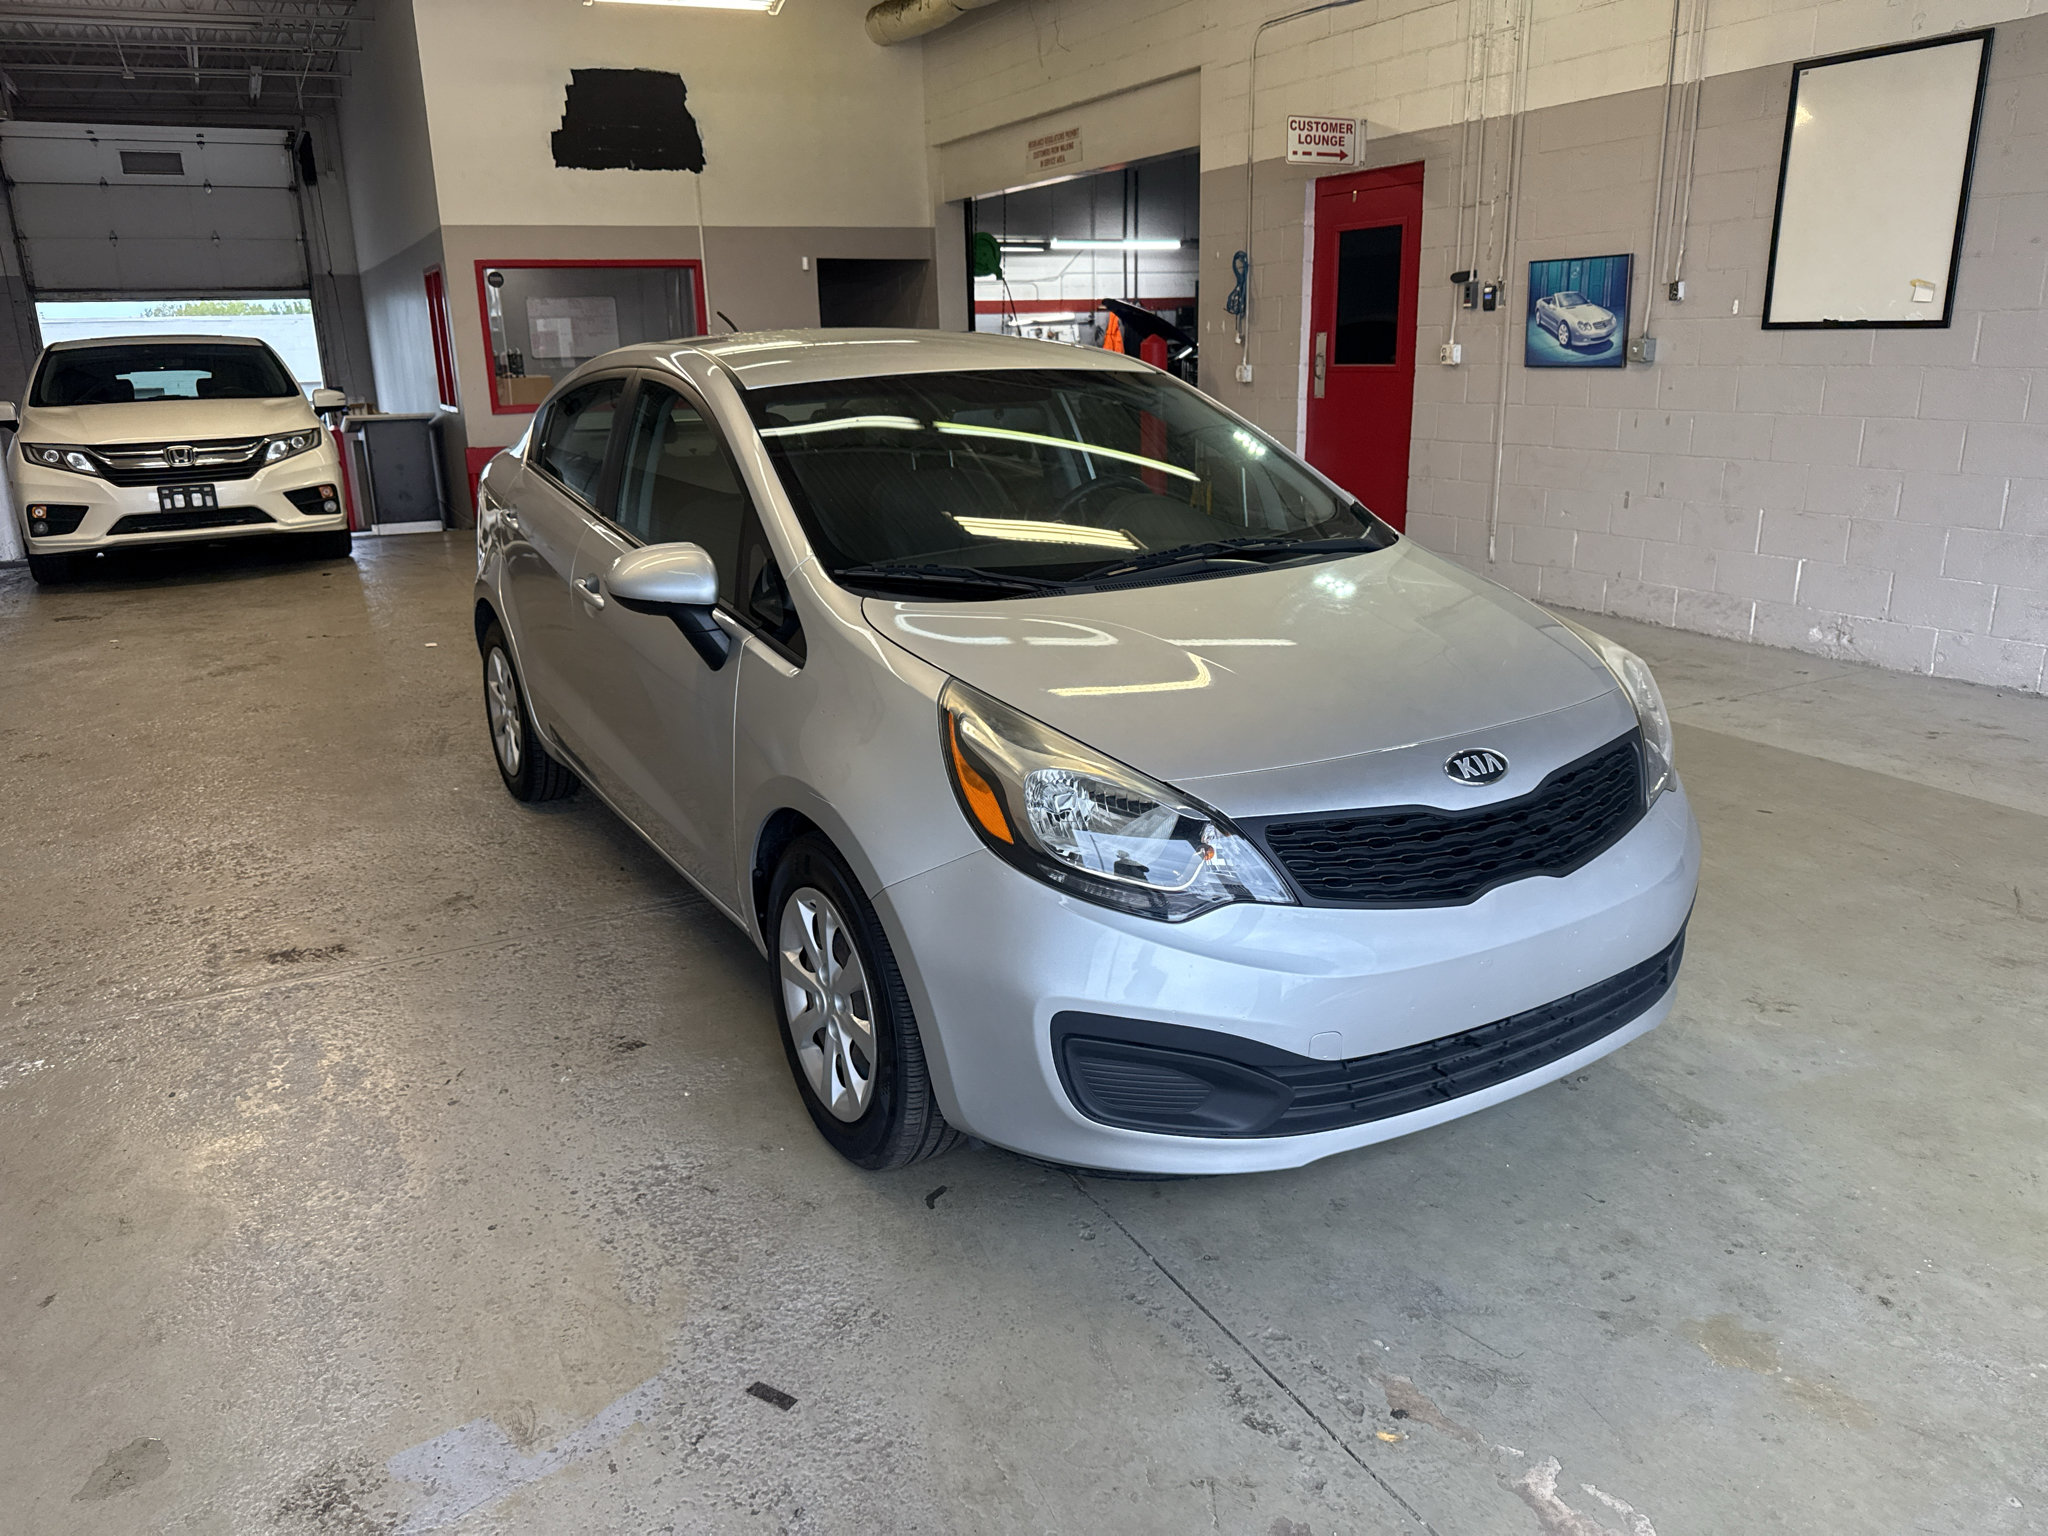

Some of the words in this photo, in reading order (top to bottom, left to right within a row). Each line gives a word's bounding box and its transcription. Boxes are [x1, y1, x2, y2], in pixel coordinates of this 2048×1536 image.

[1290, 120, 1353, 134] CUSTOMER
[1298, 133, 1345, 147] LOUNGE
[1453, 753, 1504, 779] KIA
